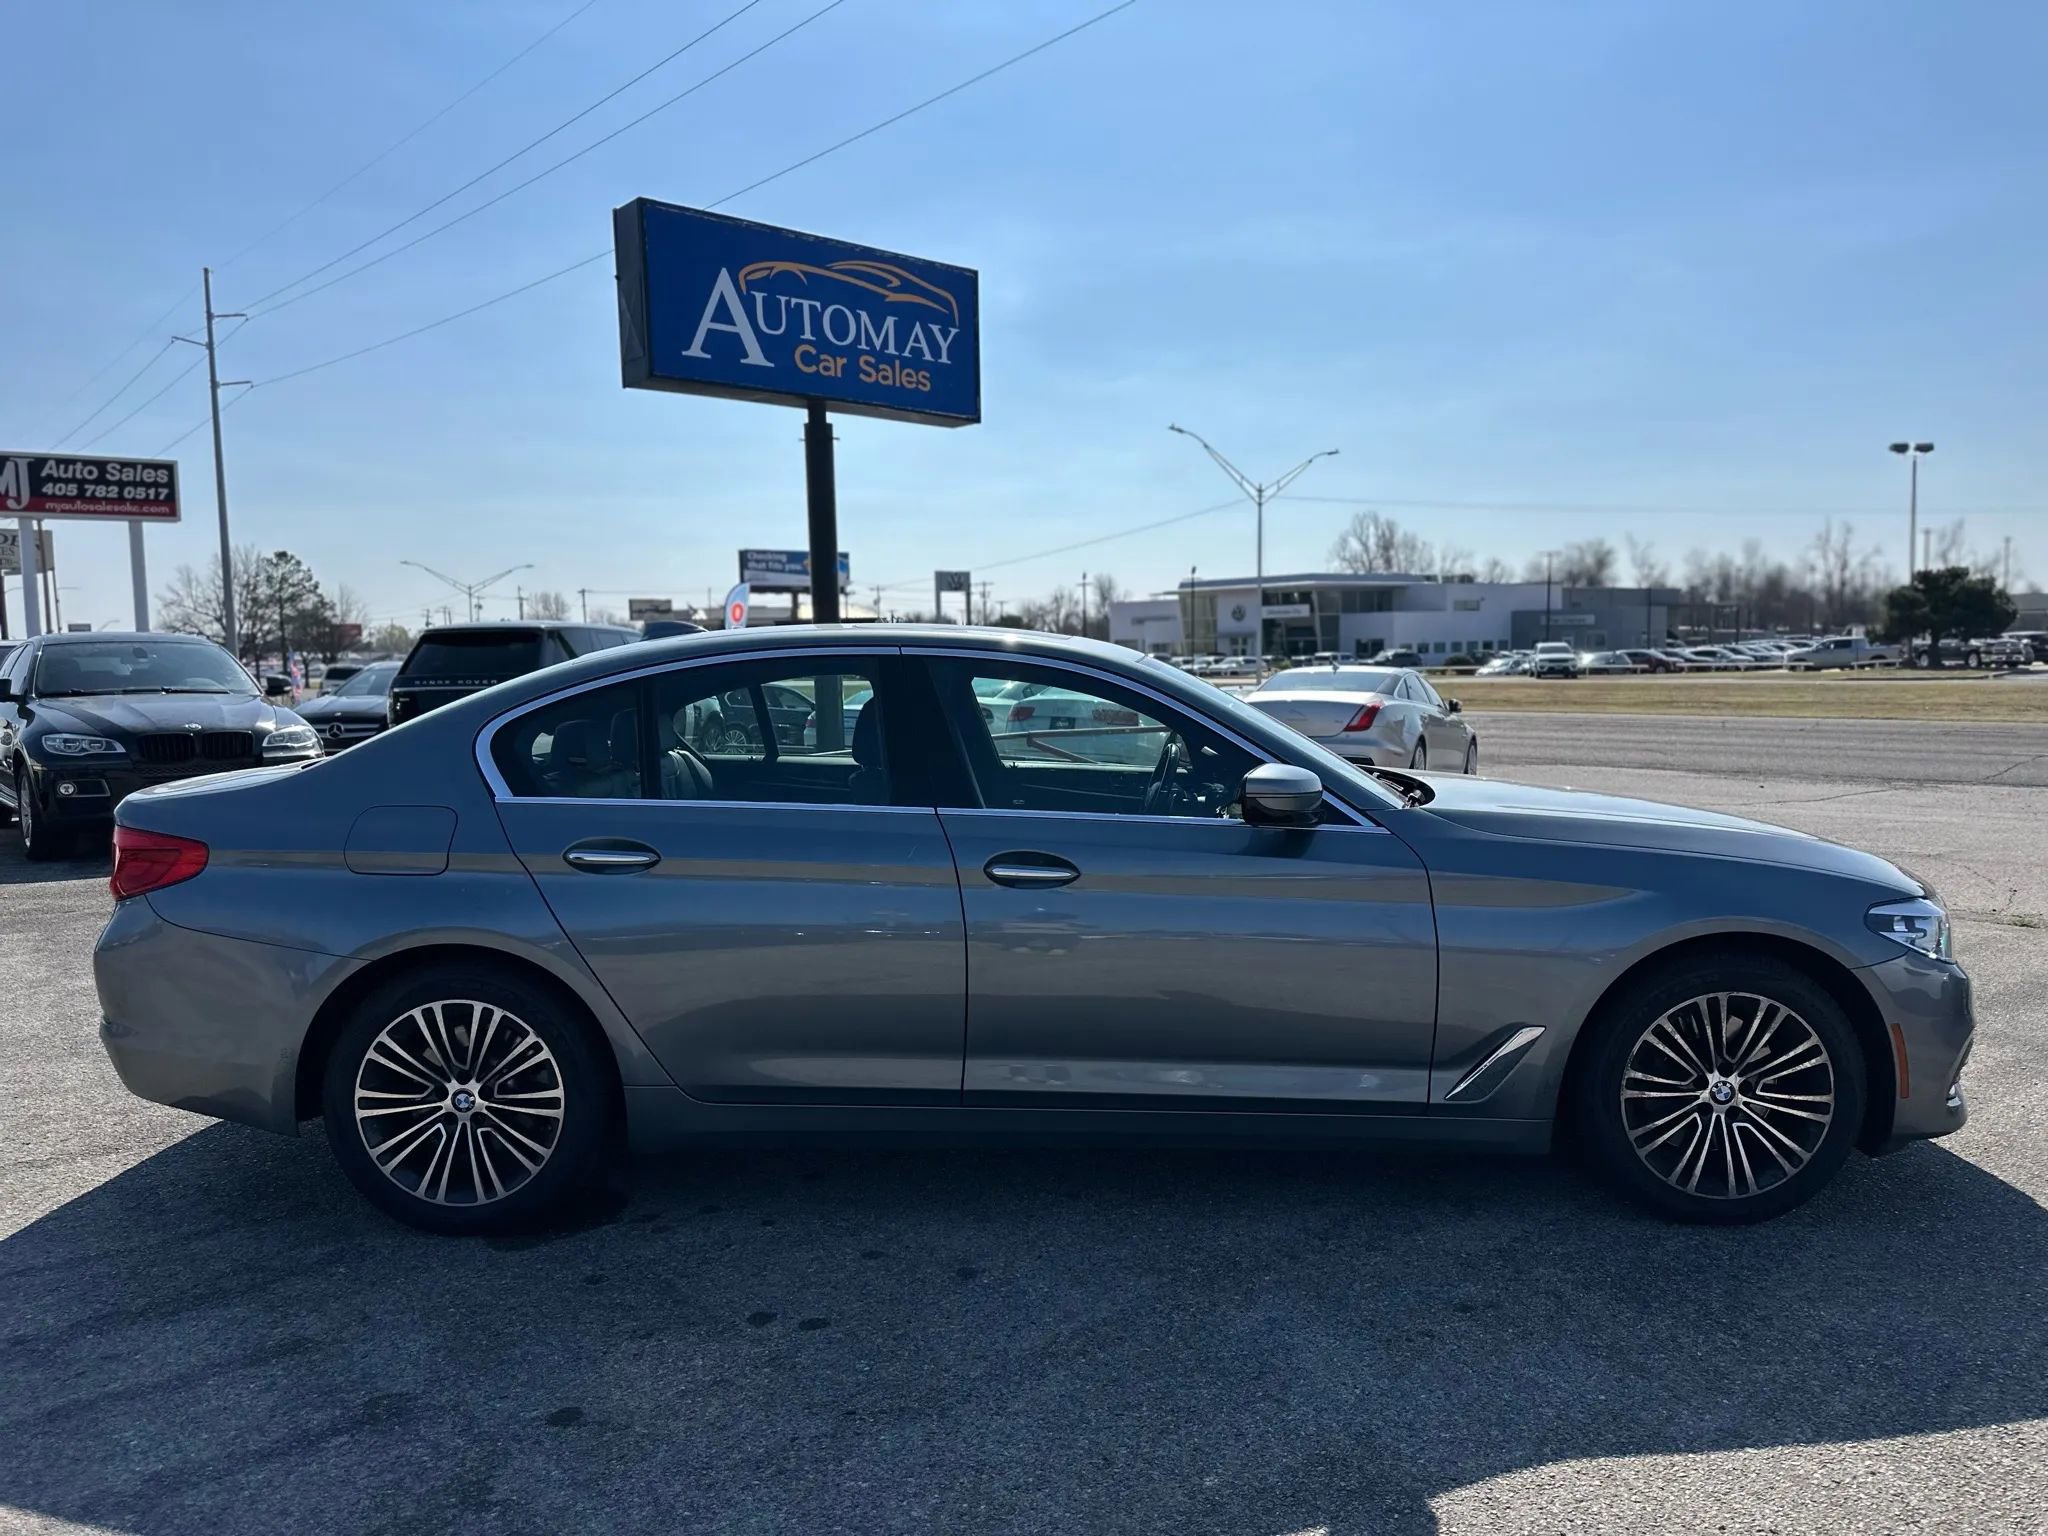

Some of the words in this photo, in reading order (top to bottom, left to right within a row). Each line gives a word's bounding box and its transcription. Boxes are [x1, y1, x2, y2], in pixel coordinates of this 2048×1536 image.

[682, 267, 960, 368] AUTOMAY
[794, 345, 847, 378] Car
[859, 354, 931, 392] Sales
[40, 459, 99, 480] Auto
[105, 463, 169, 483] Sales
[41, 483, 78, 496] 405
[84, 485, 119, 498] 782
[123, 486, 169, 500] 0517
